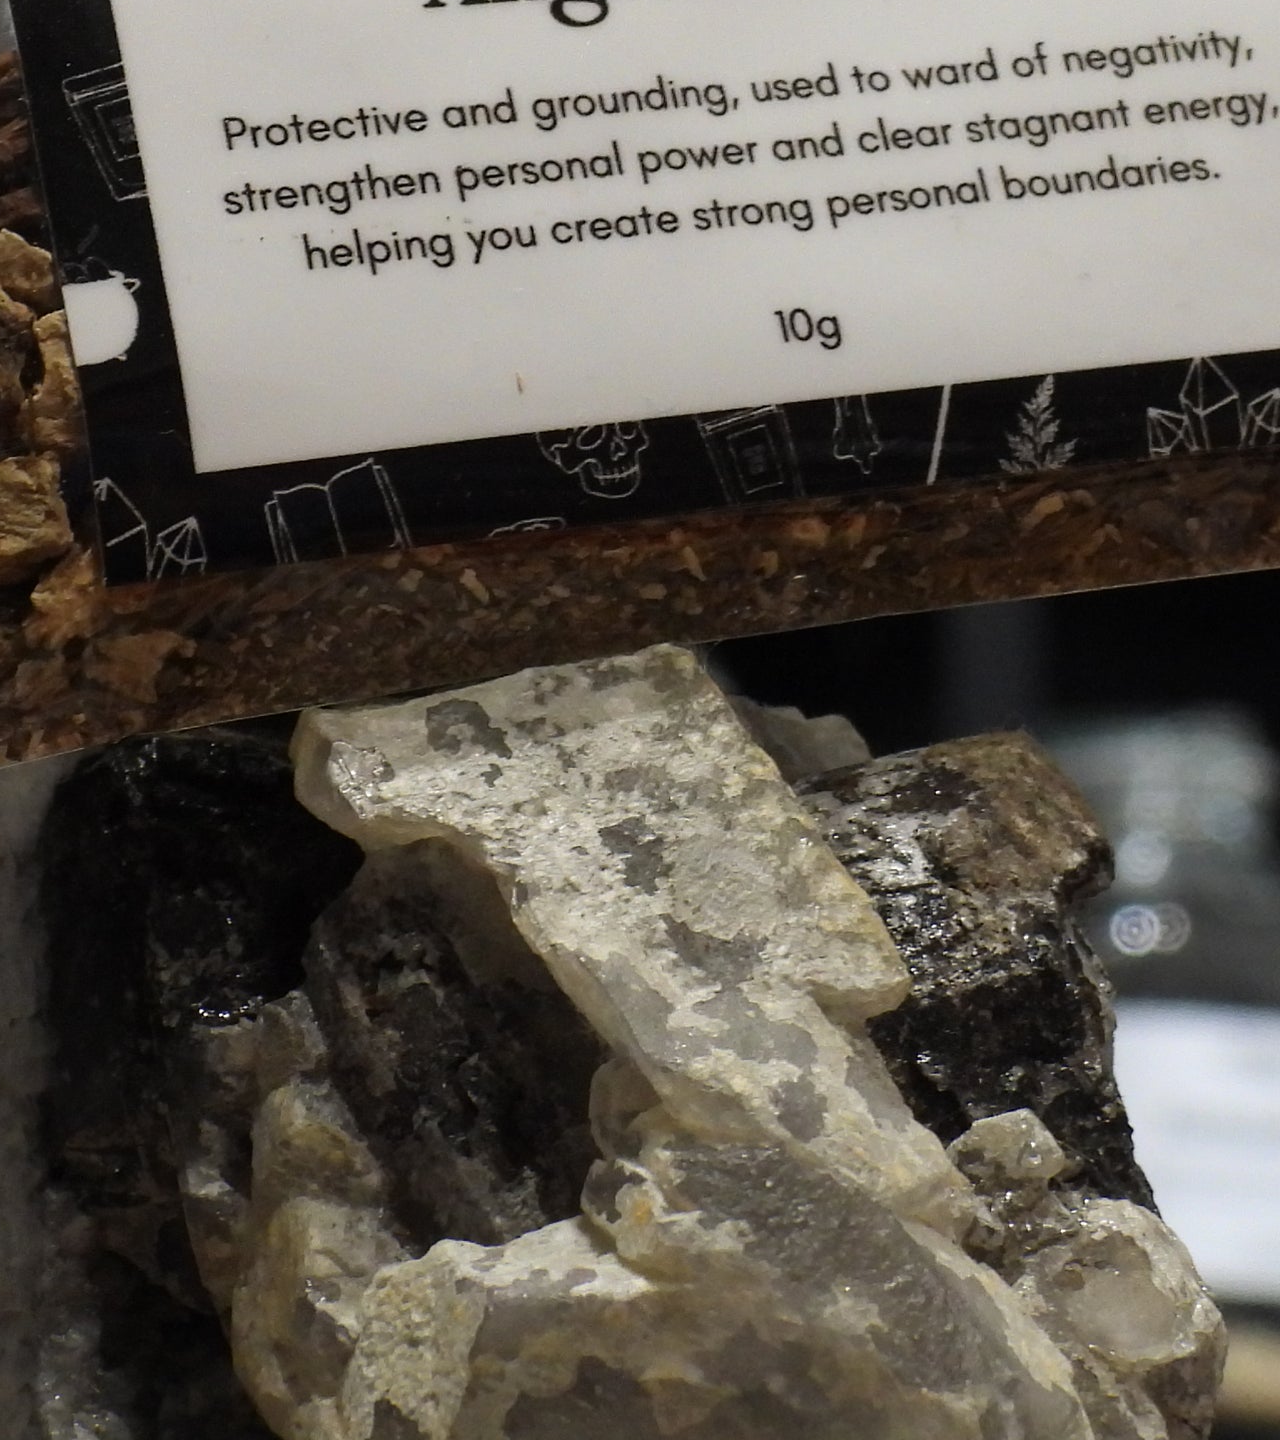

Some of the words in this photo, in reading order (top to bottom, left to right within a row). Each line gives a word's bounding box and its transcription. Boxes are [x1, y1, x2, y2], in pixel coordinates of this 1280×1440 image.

[222, 107, 429, 151] Protective
[441, 87, 519, 129] and
[531, 74, 740, 132] grounding,
[750, 61, 841, 102] used
[850, 65, 892, 94] to
[901, 46, 1000, 90] ward
[1011, 42, 1048, 79] of
[1062, 31, 1254, 79] negativity,
[222, 164, 442, 216] strengthen
[453, 139, 625, 203] personal
[636, 142, 758, 185] power
[771, 122, 845, 163] and
[857, 117, 953, 155] clear
[964, 100, 1131, 149] stagnant
[1143, 92, 1280, 128] energy,
[301, 228, 456, 275] helping
[465, 224, 539, 266] you
[549, 206, 680, 245] create
[691, 198, 815, 234] strong
[825, 168, 991, 230] personal
[998, 155, 1222, 201] boundaries.
[773, 307, 843, 351] 10g
